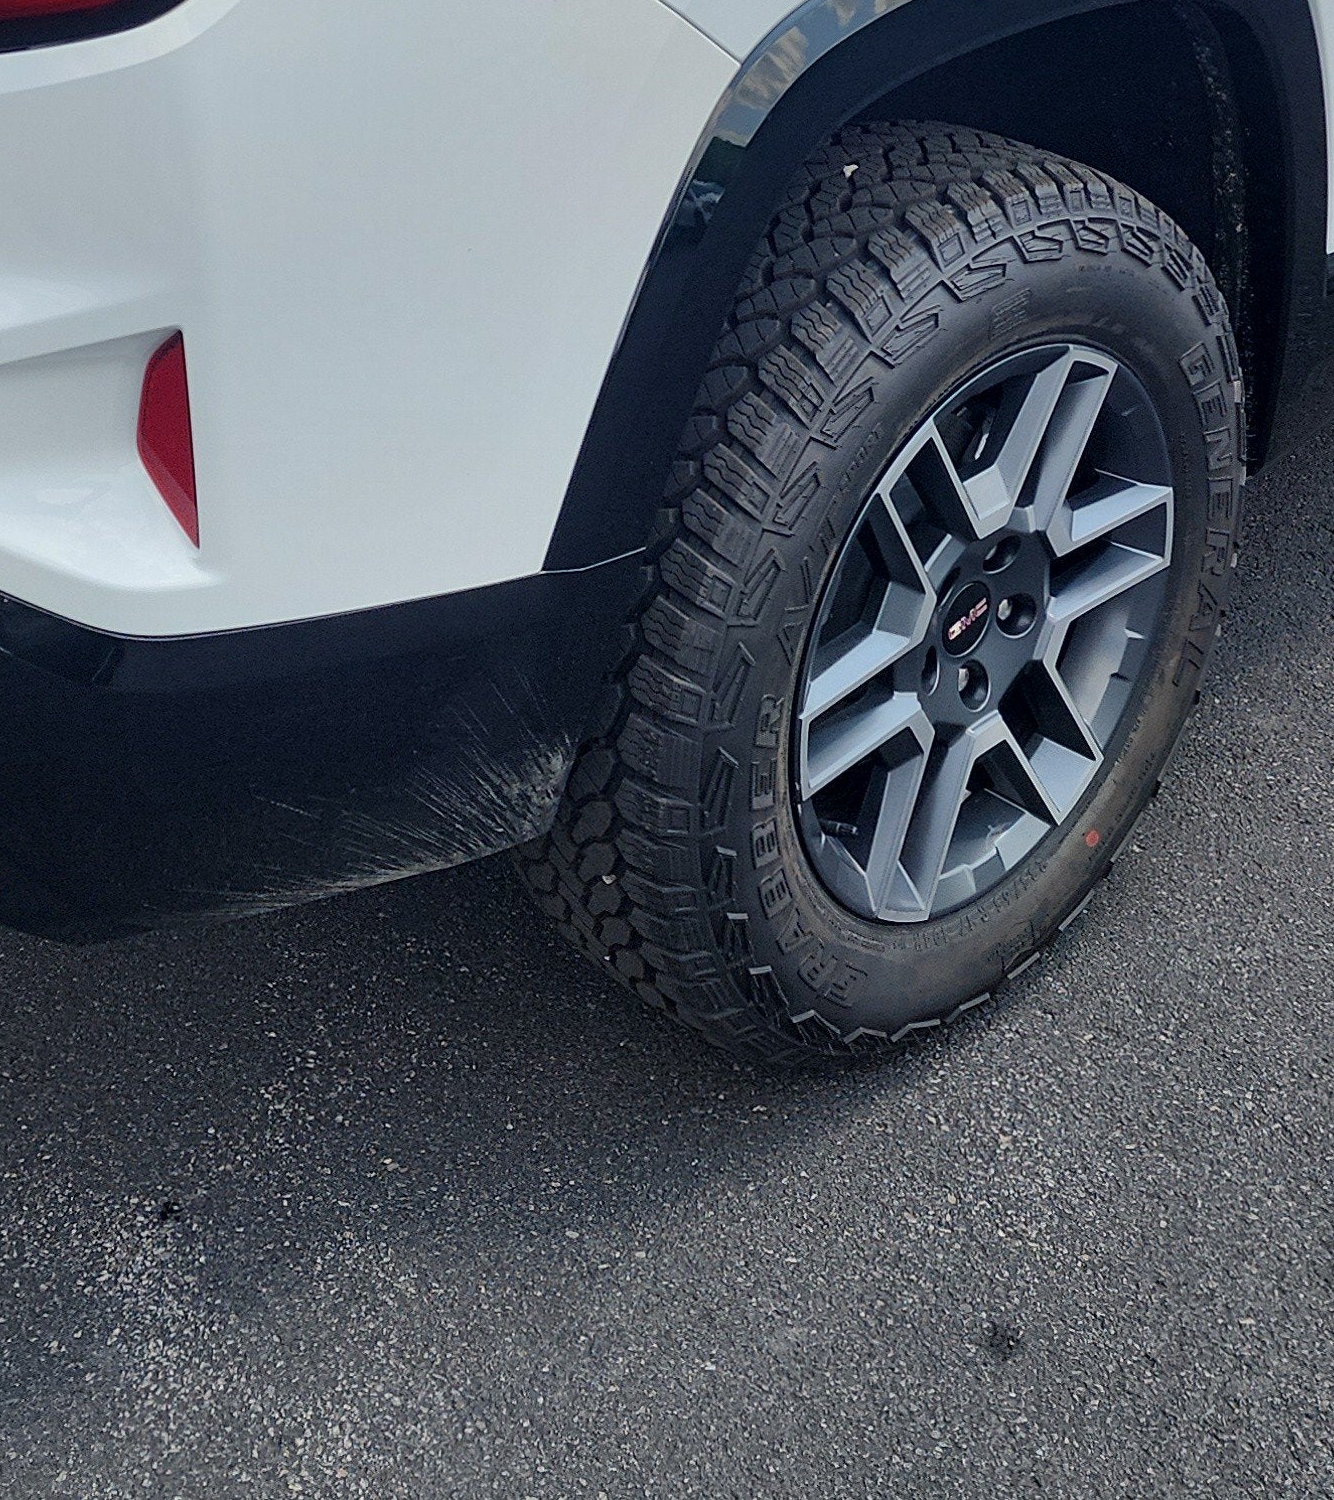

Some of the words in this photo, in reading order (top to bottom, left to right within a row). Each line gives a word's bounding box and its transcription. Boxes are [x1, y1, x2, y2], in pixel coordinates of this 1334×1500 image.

[947, 597, 988, 641] GMC
[1173, 342, 1233, 687] GENERAL
[750, 693, 868, 1009] GRABBER
